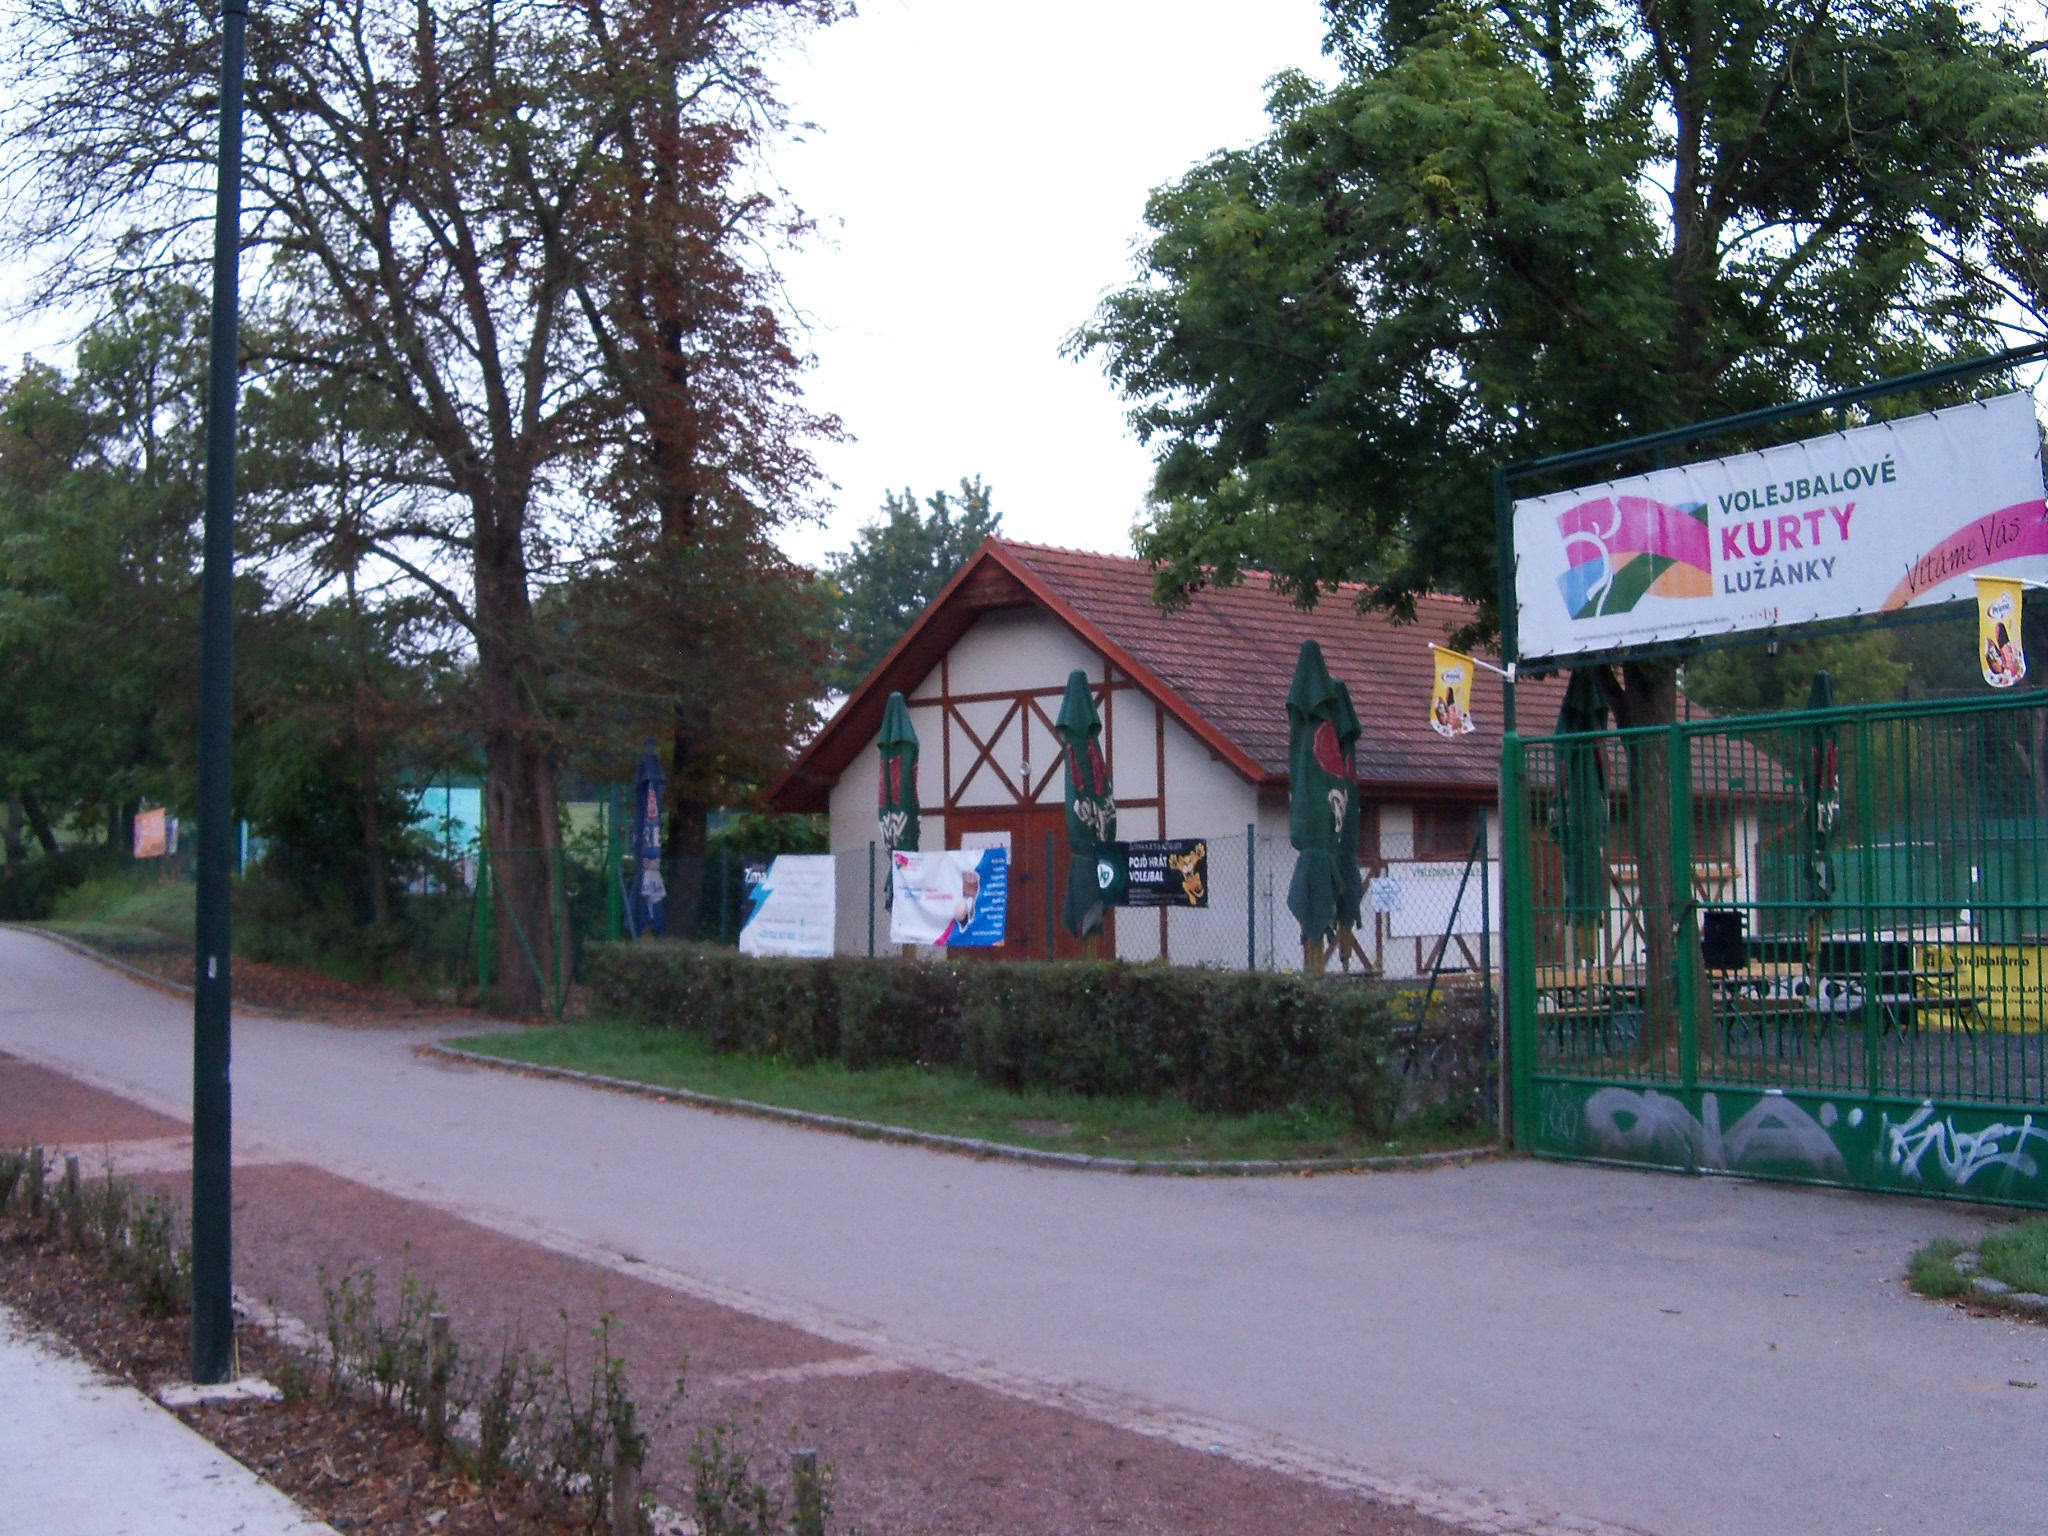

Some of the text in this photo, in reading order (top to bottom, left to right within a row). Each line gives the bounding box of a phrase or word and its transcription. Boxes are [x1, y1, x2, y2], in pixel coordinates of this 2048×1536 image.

[1718, 453, 1896, 514] VOLEJBALOVÉ
[1721, 502, 1856, 561] KURTY
[1980, 514, 2021, 556] Vás
[1723, 556, 1836, 594] LUŽÁNKY
[1129, 870, 1164, 882] VOLEJBAL
